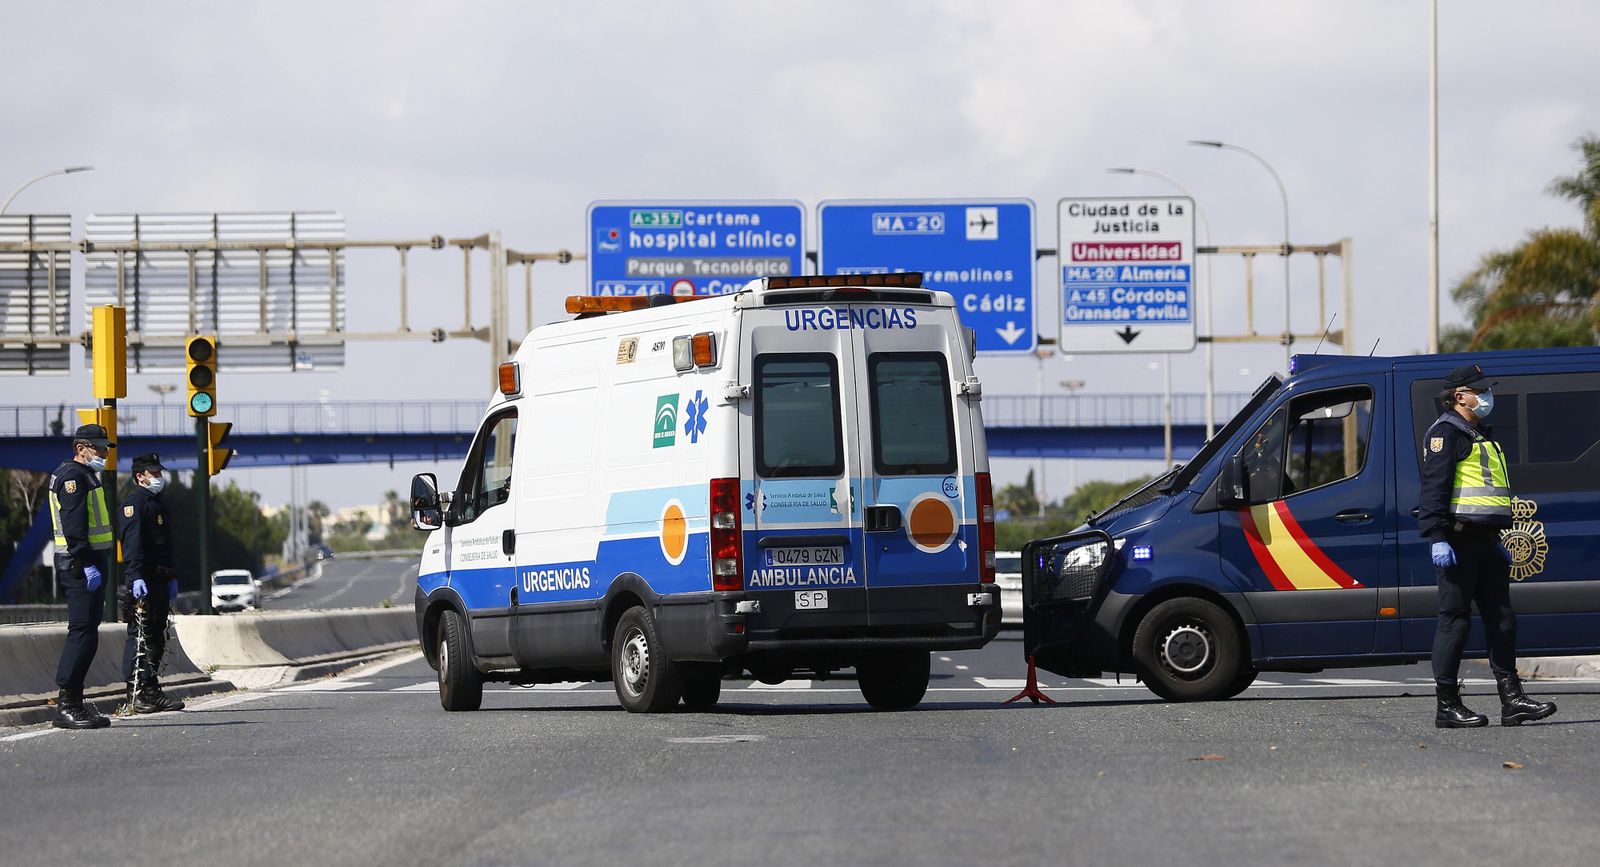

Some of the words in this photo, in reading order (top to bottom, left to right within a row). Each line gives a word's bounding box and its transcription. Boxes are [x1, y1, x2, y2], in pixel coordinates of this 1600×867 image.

[1068, 203, 1130, 216] Ciudad
[1138, 203, 1158, 216] de
[1168, 203, 1184, 216] la
[632, 211, 681, 225] A-357
[684, 211, 760, 226] Cartama
[876, 215, 942, 231] MA-20
[1093, 219, 1160, 233] Justicia
[629, 230, 716, 251] hospital
[725, 230, 797, 248] clínico
[1073, 243, 1180, 260] Universidad
[628, 259, 685, 276] Parque
[693, 259, 789, 277] Tecnológico
[1068, 267, 1116, 281] MA-20
[1120, 265, 1187, 281] Almería
[963, 293, 1026, 312] Cádiz
[1070, 289, 1107, 303] A-45
[784, 307, 918, 331] URGENCIAS
[777, 549, 810, 564] 0479
[814, 548, 838, 563] GZN
[522, 567, 591, 593] URGENCIAS
[749, 567, 857, 587] AMBULANCIA
